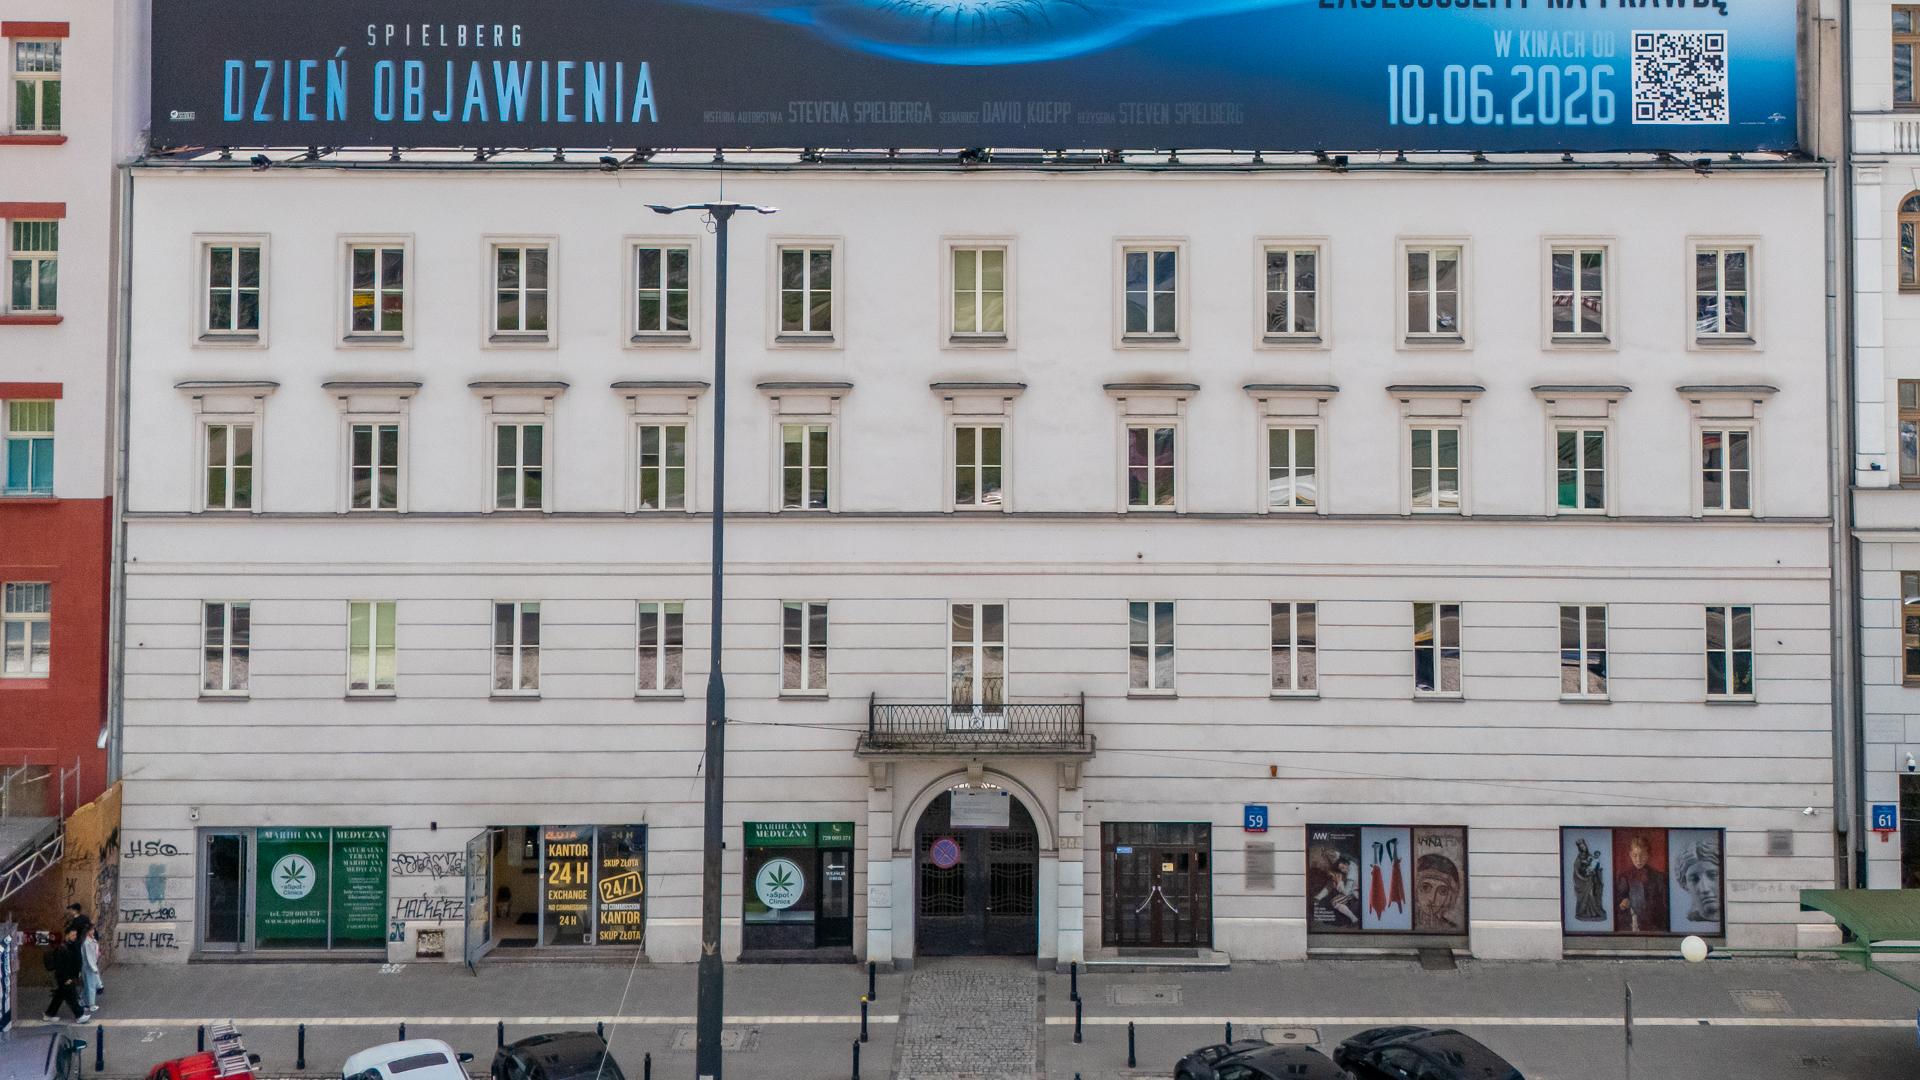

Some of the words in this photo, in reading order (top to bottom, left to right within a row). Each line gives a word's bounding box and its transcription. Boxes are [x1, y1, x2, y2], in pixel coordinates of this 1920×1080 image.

[367, 24, 523, 47] SPIELBERG
[1493, 30, 1512, 57] W
[1519, 30, 1586, 58] KINACH
[1592, 30, 1616, 58] OD
[222, 47, 348, 122] DZIEŃ
[373, 60, 660, 123] OBJAWIENIA
[1387, 63, 1616, 125] 10.06.2026
[788, 101, 850, 124] STEVENA
[853, 101, 933, 124] SPIELBERGA
[982, 101, 1021, 124] DAVID
[1029, 101, 1072, 124] KOEPP
[1119, 101, 1169, 124] STEVEN
[1175, 101, 1244, 124] SPIELBERG
[1249, 815, 1264, 828] 59
[1878, 814, 1891, 827] 61
[264, 831, 323, 839] MARIHUANA
[336, 831, 386, 839] MEDYCZNA
[755, 830, 807, 838] MEDYCZNA
[548, 843, 589, 857] KANTOR
[603, 858, 620, 868] SKUP
[620, 858, 639, 868] ZŁOTA
[548, 862, 572, 885] 24
[576, 862, 589, 885] H
[603, 874, 637, 900] 24/7
[548, 889, 588, 900] EXCHANGE
[559, 915, 569, 926] 24
[571, 915, 577, 925] H
[600, 911, 640, 924] KANTOR
[600, 930, 618, 940] SKUP
[619, 930, 641, 940] ZŁOTA
